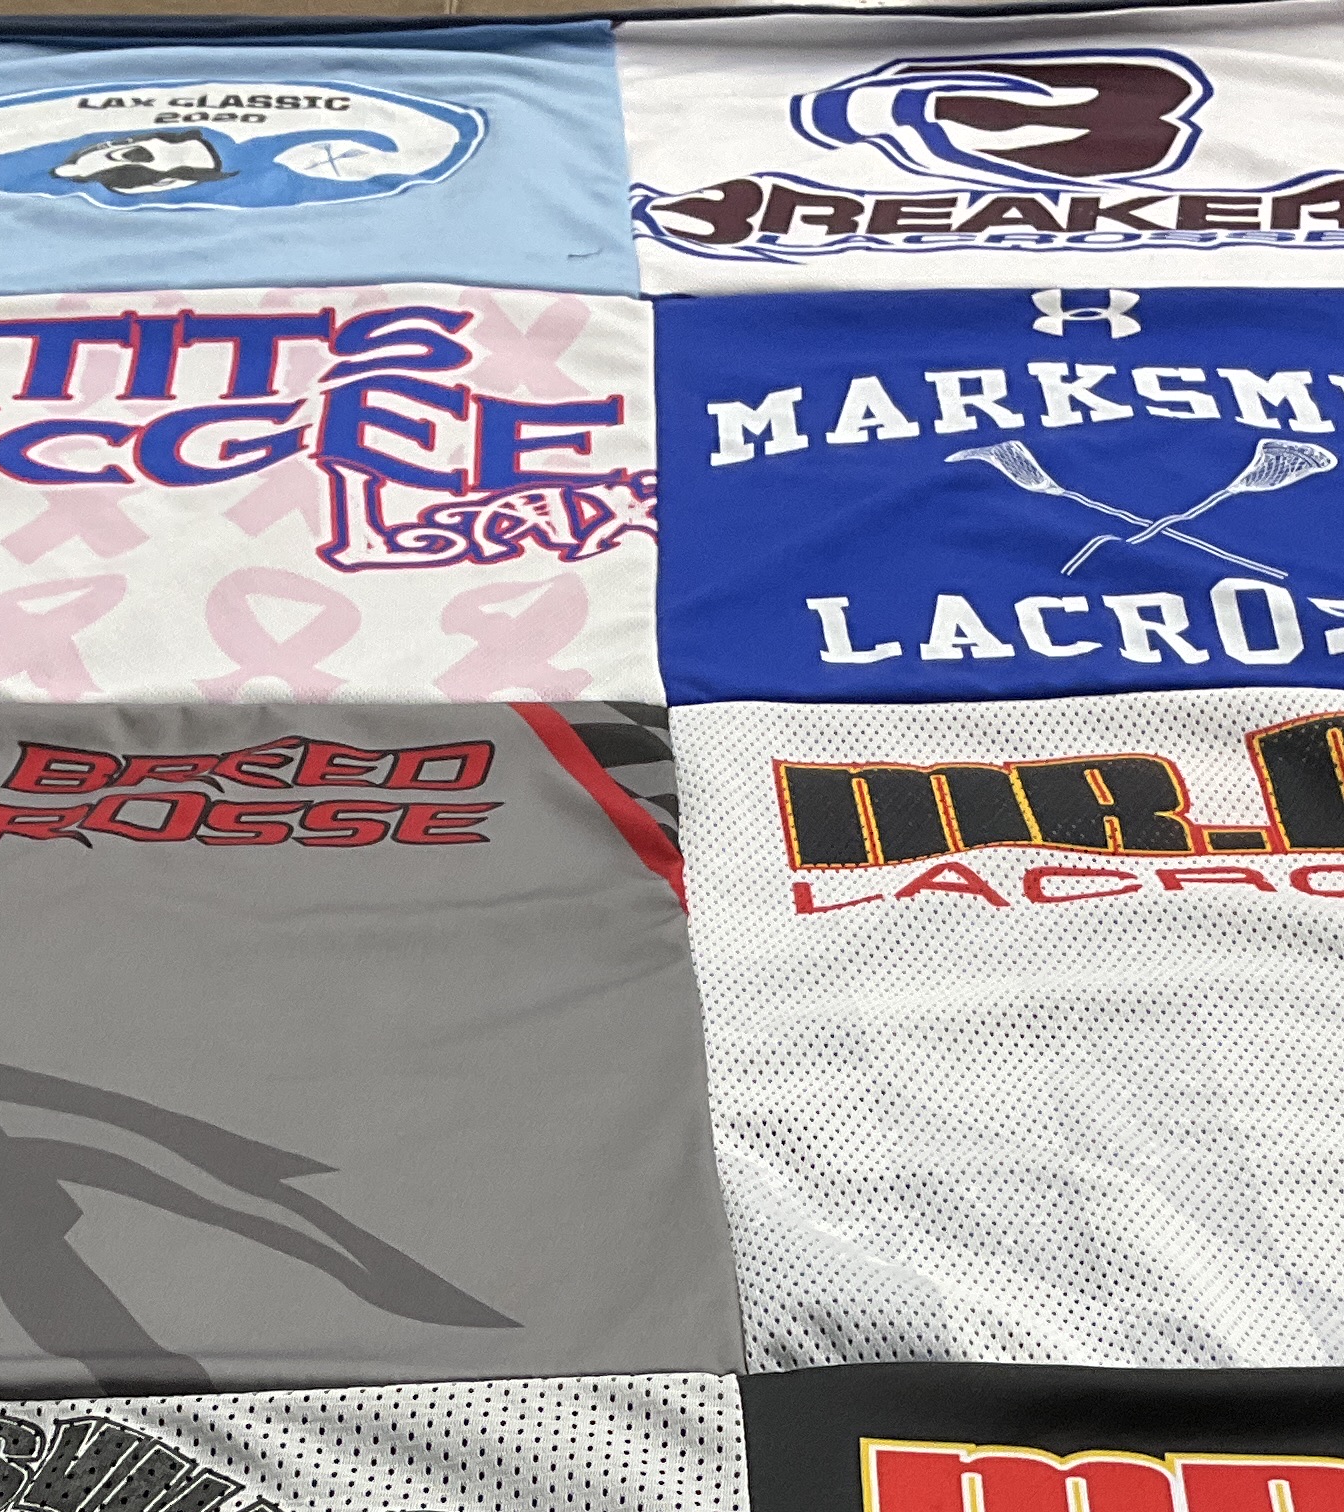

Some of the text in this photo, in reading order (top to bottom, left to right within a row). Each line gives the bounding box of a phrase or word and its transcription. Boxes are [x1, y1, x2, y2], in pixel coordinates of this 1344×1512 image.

[77, 93, 352, 112] LAX CLASSIC
[153, 111, 268, 124] 2020
[1, 735, 496, 795] BREED
